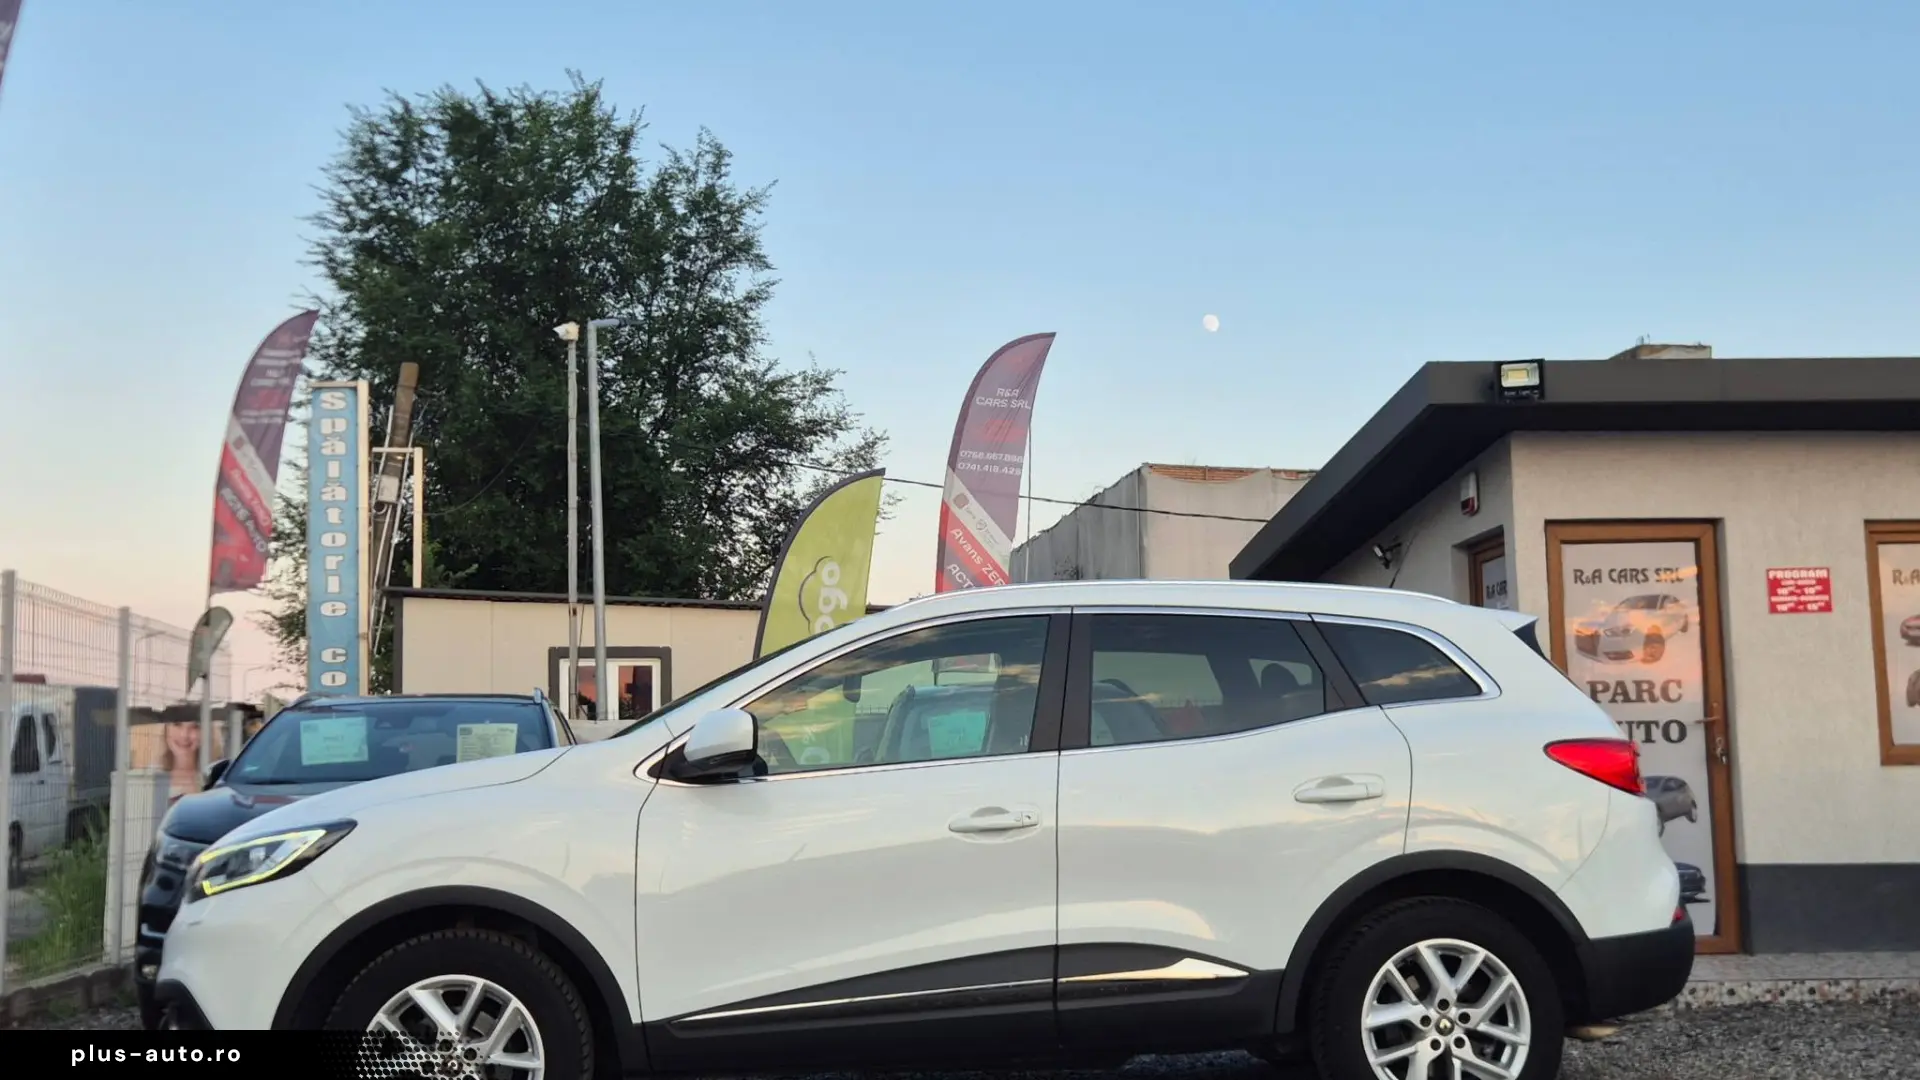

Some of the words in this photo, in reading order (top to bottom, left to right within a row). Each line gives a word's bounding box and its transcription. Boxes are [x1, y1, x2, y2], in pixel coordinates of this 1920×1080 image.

[996, 387, 1020, 398] R&A
[975, 396, 1009, 408] CARS
[1010, 399, 1032, 410] SRL
[950, 528, 984, 565] Avans
[946, 563, 976, 589] ACT
[1608, 567, 1649, 585] CARS
[1654, 567, 1685, 584] SRL
[1768, 569, 1828, 580] PROGRAM
[1585, 679, 1684, 704] PARC
